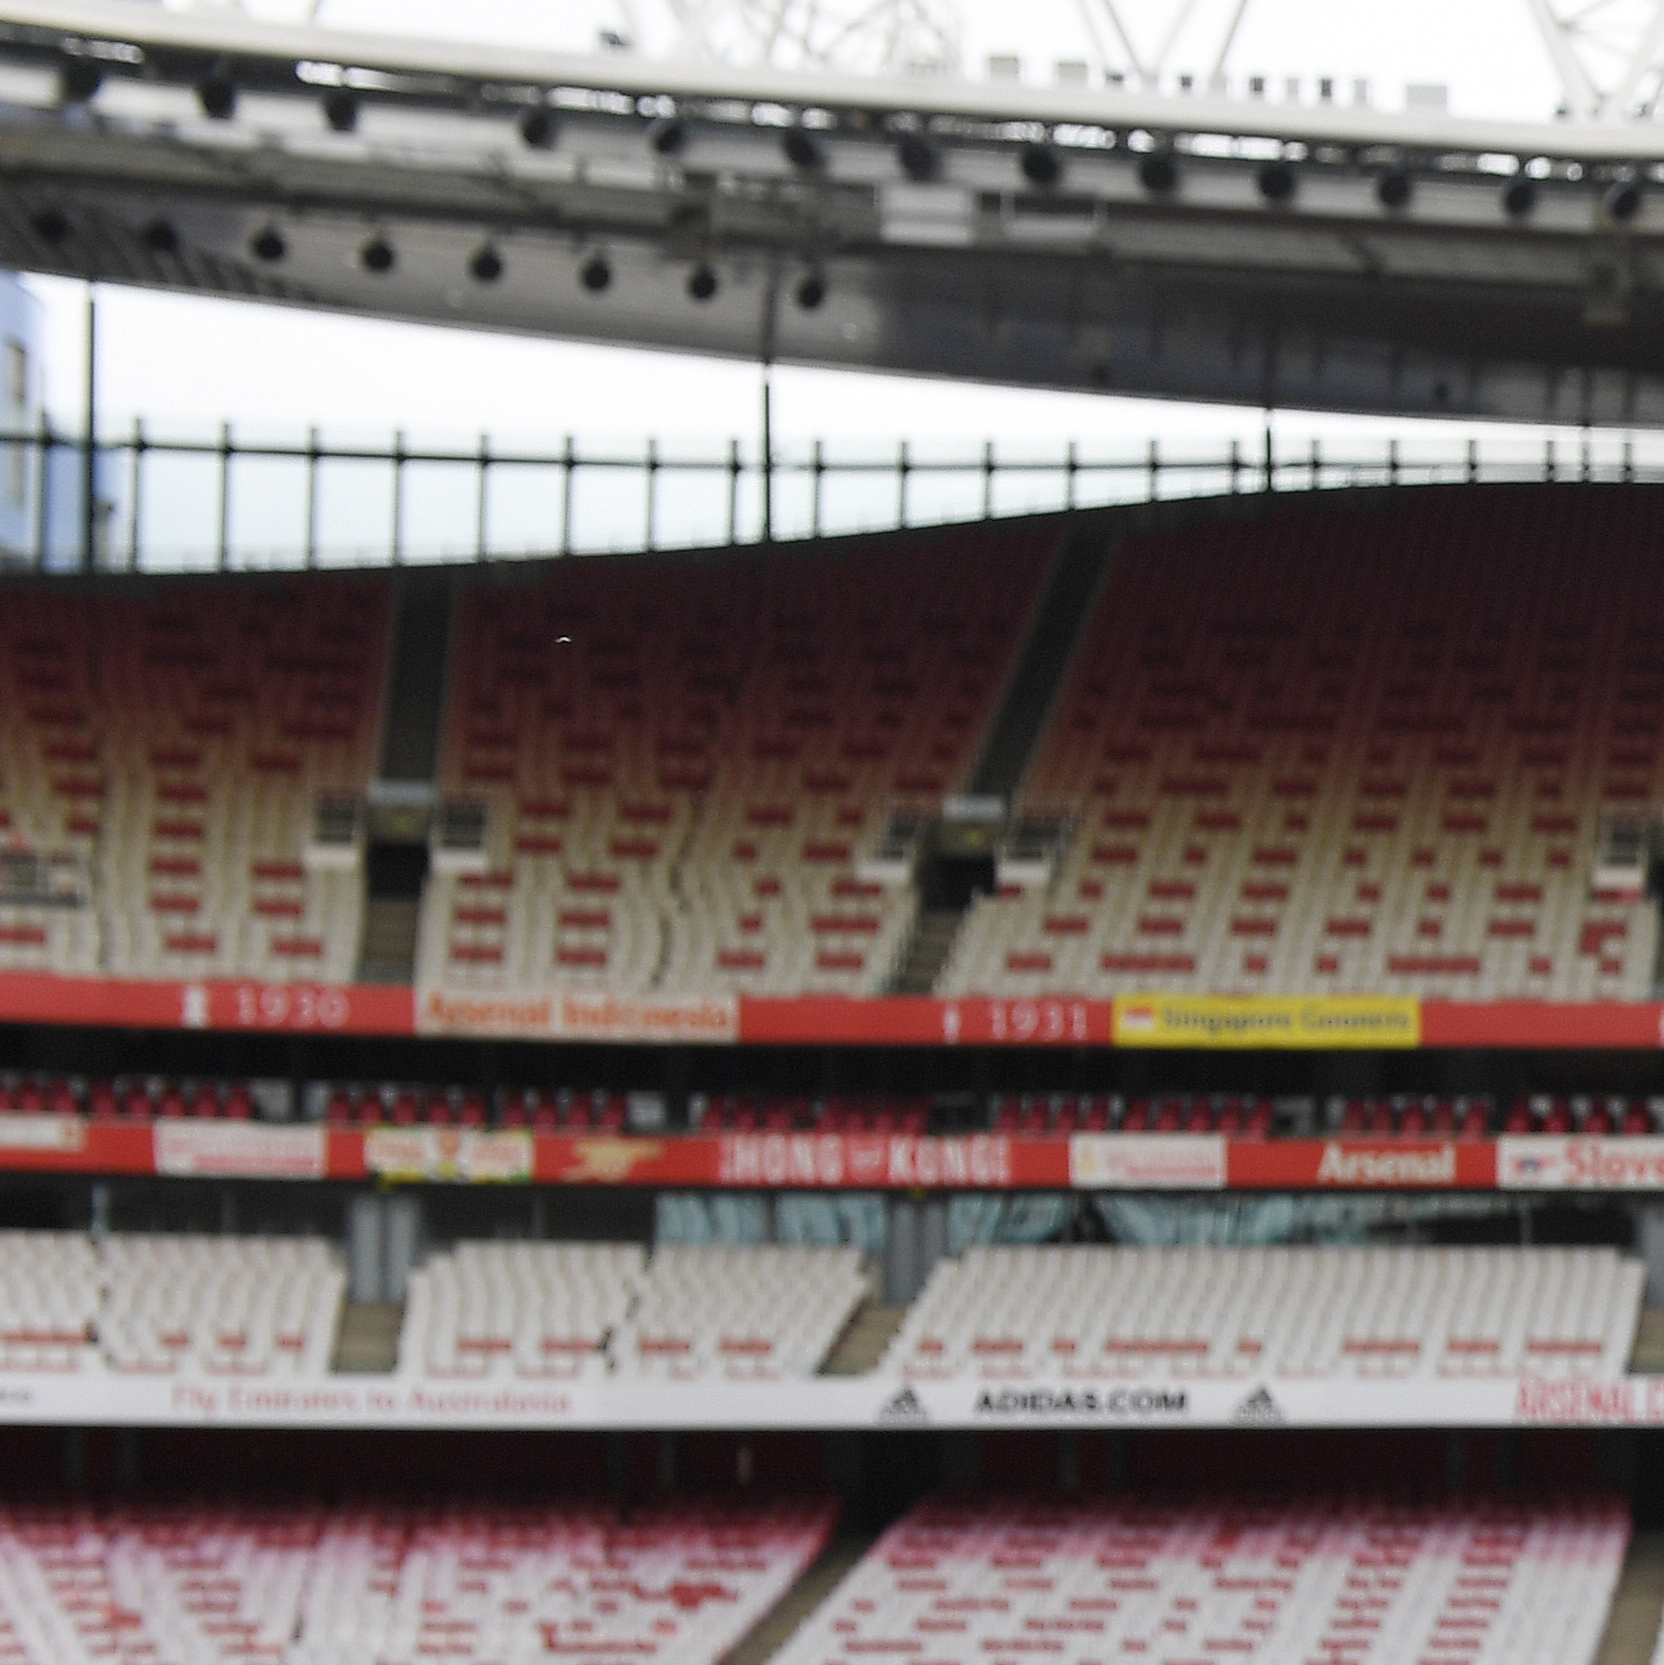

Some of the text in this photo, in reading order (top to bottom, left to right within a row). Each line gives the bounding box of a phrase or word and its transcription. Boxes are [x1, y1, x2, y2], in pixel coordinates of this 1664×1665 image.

[236, 988, 349, 1028] 1930
[990, 1003, 1088, 1041] 1931
[733, 1134, 843, 1183] HONG
[888, 1134, 997, 1184] KONG
[1317, 1139, 1457, 1185] Arsenal
[974, 1388, 1188, 1415] ADIDAS.COM
